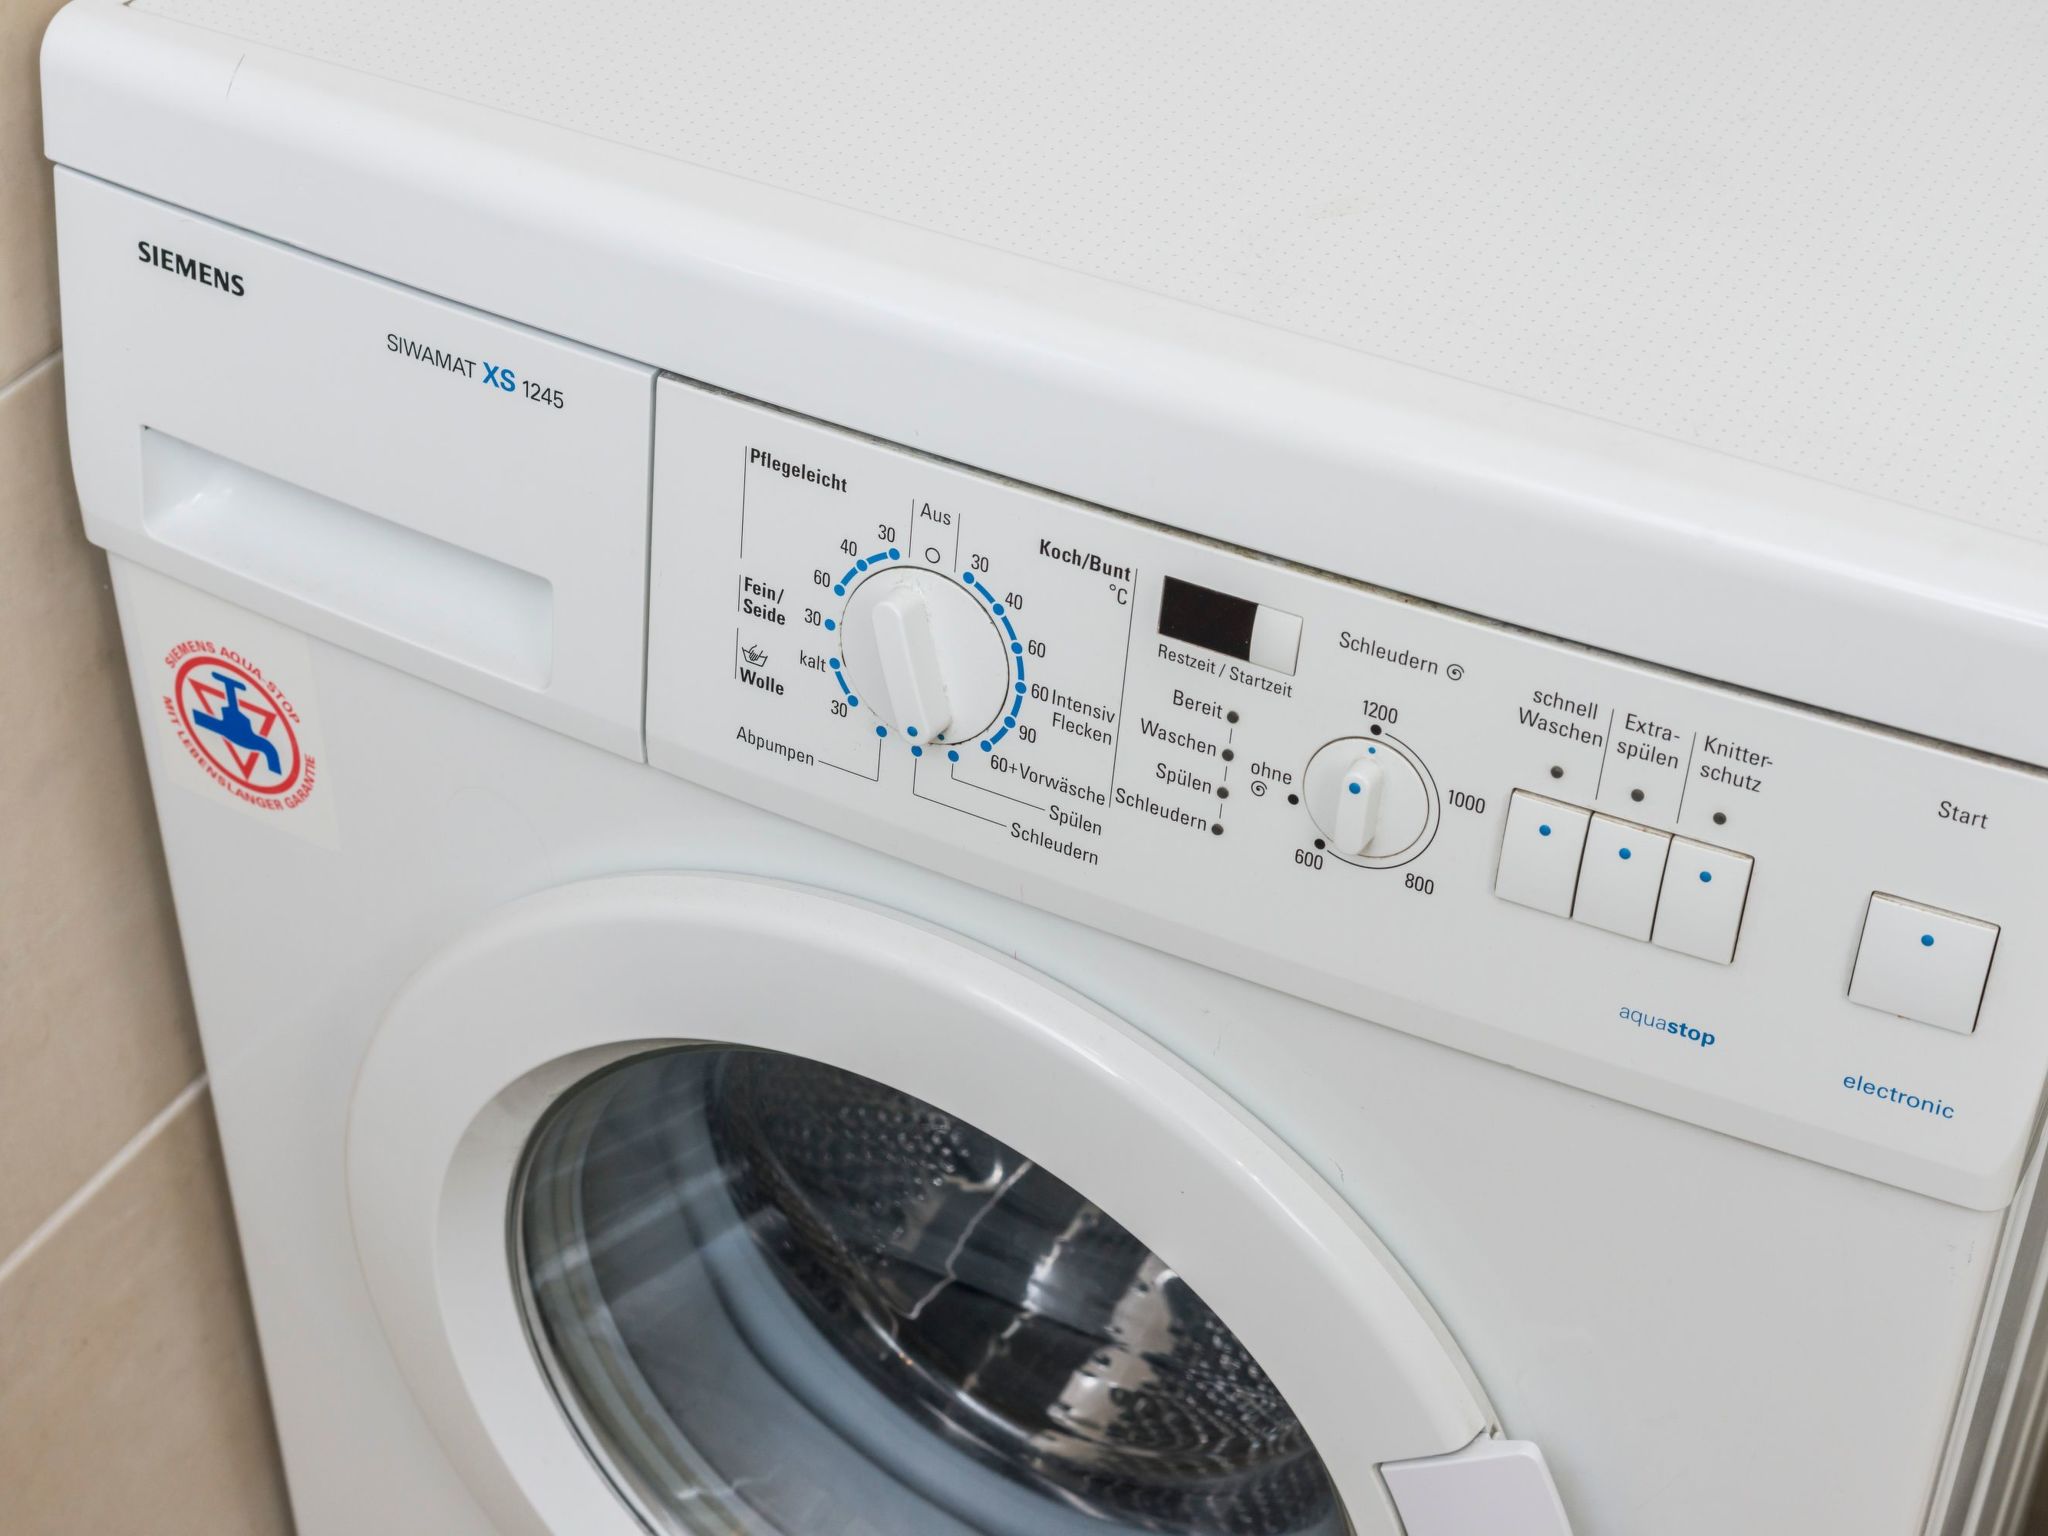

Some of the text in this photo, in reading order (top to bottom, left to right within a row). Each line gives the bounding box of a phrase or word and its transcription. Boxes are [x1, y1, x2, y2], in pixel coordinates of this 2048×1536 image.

[137, 241, 245, 297] SIEMENS
[386, 333, 565, 409] SIWAMAT XS 1245
[750, 448, 847, 493] Pflegeleicht
[919, 503, 952, 526] Aus
[840, 540, 857, 557] 40
[878, 524, 896, 543] 30
[971, 554, 989, 573] 30
[1039, 539, 1131, 582] Koch/Bunt
[744, 577, 784, 604] Fein/
[814, 569, 831, 587] 60
[743, 601, 786, 626] Seide
[1004, 592, 1023, 610] 40
[804, 608, 821, 626] 30
[165, 640, 215, 669] SIEMENS
[800, 651, 826, 673] kalt
[1028, 640, 1046, 658] 60
[1339, 632, 1438, 674] Schleudern
[740, 667, 785, 696] Wolle
[1158, 644, 1216, 676] Restzeit
[1229, 666, 1292, 697] Startzeit
[830, 700, 848, 718] 30
[1031, 684, 1116, 724] 60 Intensiv
[1173, 689, 1222, 720] Bereit
[1362, 700, 1398, 724] 1200
[1533, 688, 1599, 719] schnell
[1019, 726, 1037, 743] 90
[1051, 713, 1112, 746] Flecken
[1141, 718, 1217, 757] Waschen
[1519, 707, 1603, 747] Waschen
[1625, 714, 1681, 743] Extra-
[163, 695, 316, 811] MIT LEBENSLANGER GARANTIE
[736, 727, 815, 766] Abpumpen
[1617, 738, 1679, 770] spülen
[1704, 735, 1773, 769] Knitter-
[990, 755, 1105, 806] 60+Vorwäsche
[1156, 762, 1212, 794] Spülen
[1251, 762, 1292, 785] ohne
[1700, 762, 1762, 793] schutz
[1115, 788, 1207, 832] Schleudern
[1448, 790, 1485, 814] 1000
[1937, 800, 1988, 830] Start
[1049, 805, 1103, 836] Spülen
[1010, 823, 1099, 866] Schleudern
[1294, 849, 1323, 870] 600
[1404, 873, 1434, 895] 800
[1619, 1005, 1715, 1047] aquastop
[1842, 1074, 1955, 1120] electronic
